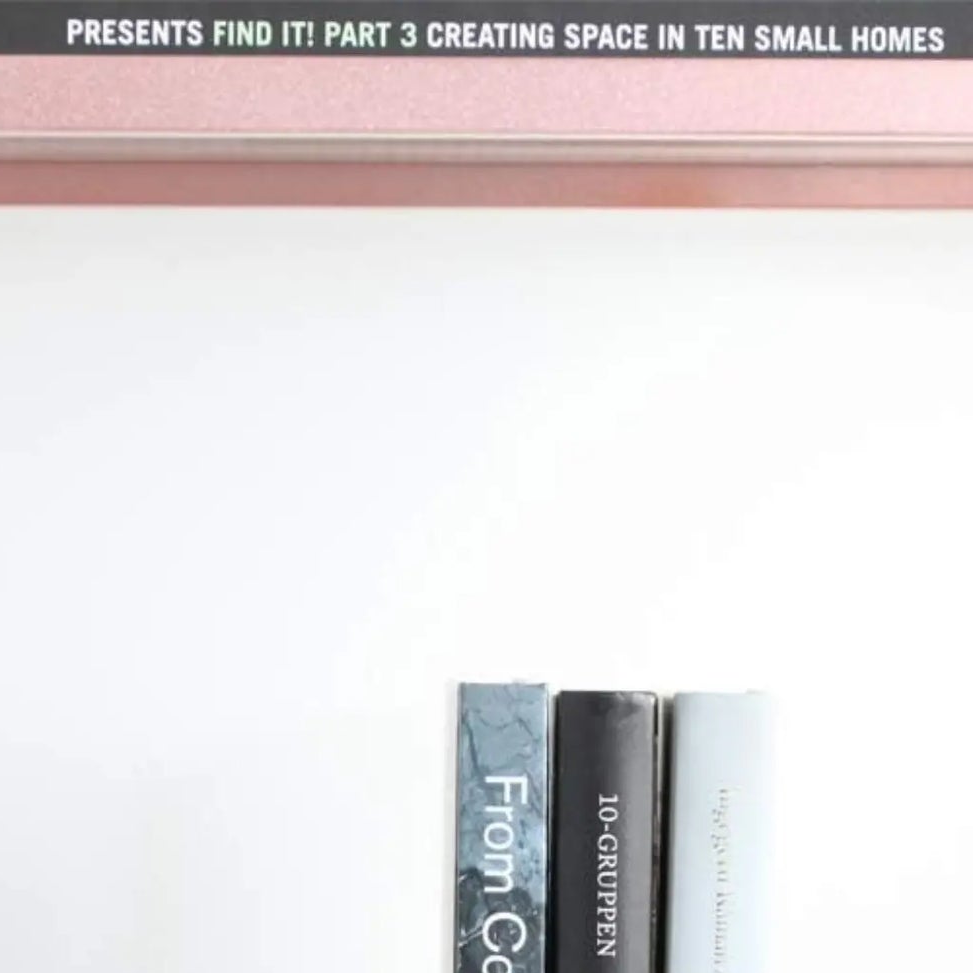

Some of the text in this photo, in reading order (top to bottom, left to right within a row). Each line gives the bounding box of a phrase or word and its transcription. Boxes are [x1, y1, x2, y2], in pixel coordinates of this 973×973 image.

[66, 18, 945, 53] PRESENTS FIND IT! PART 3 CREATING SPACE IN TEN SMALL HOMES
[484, 775, 528, 893] From
[596, 793, 619, 958] 10-GRUPPEN
